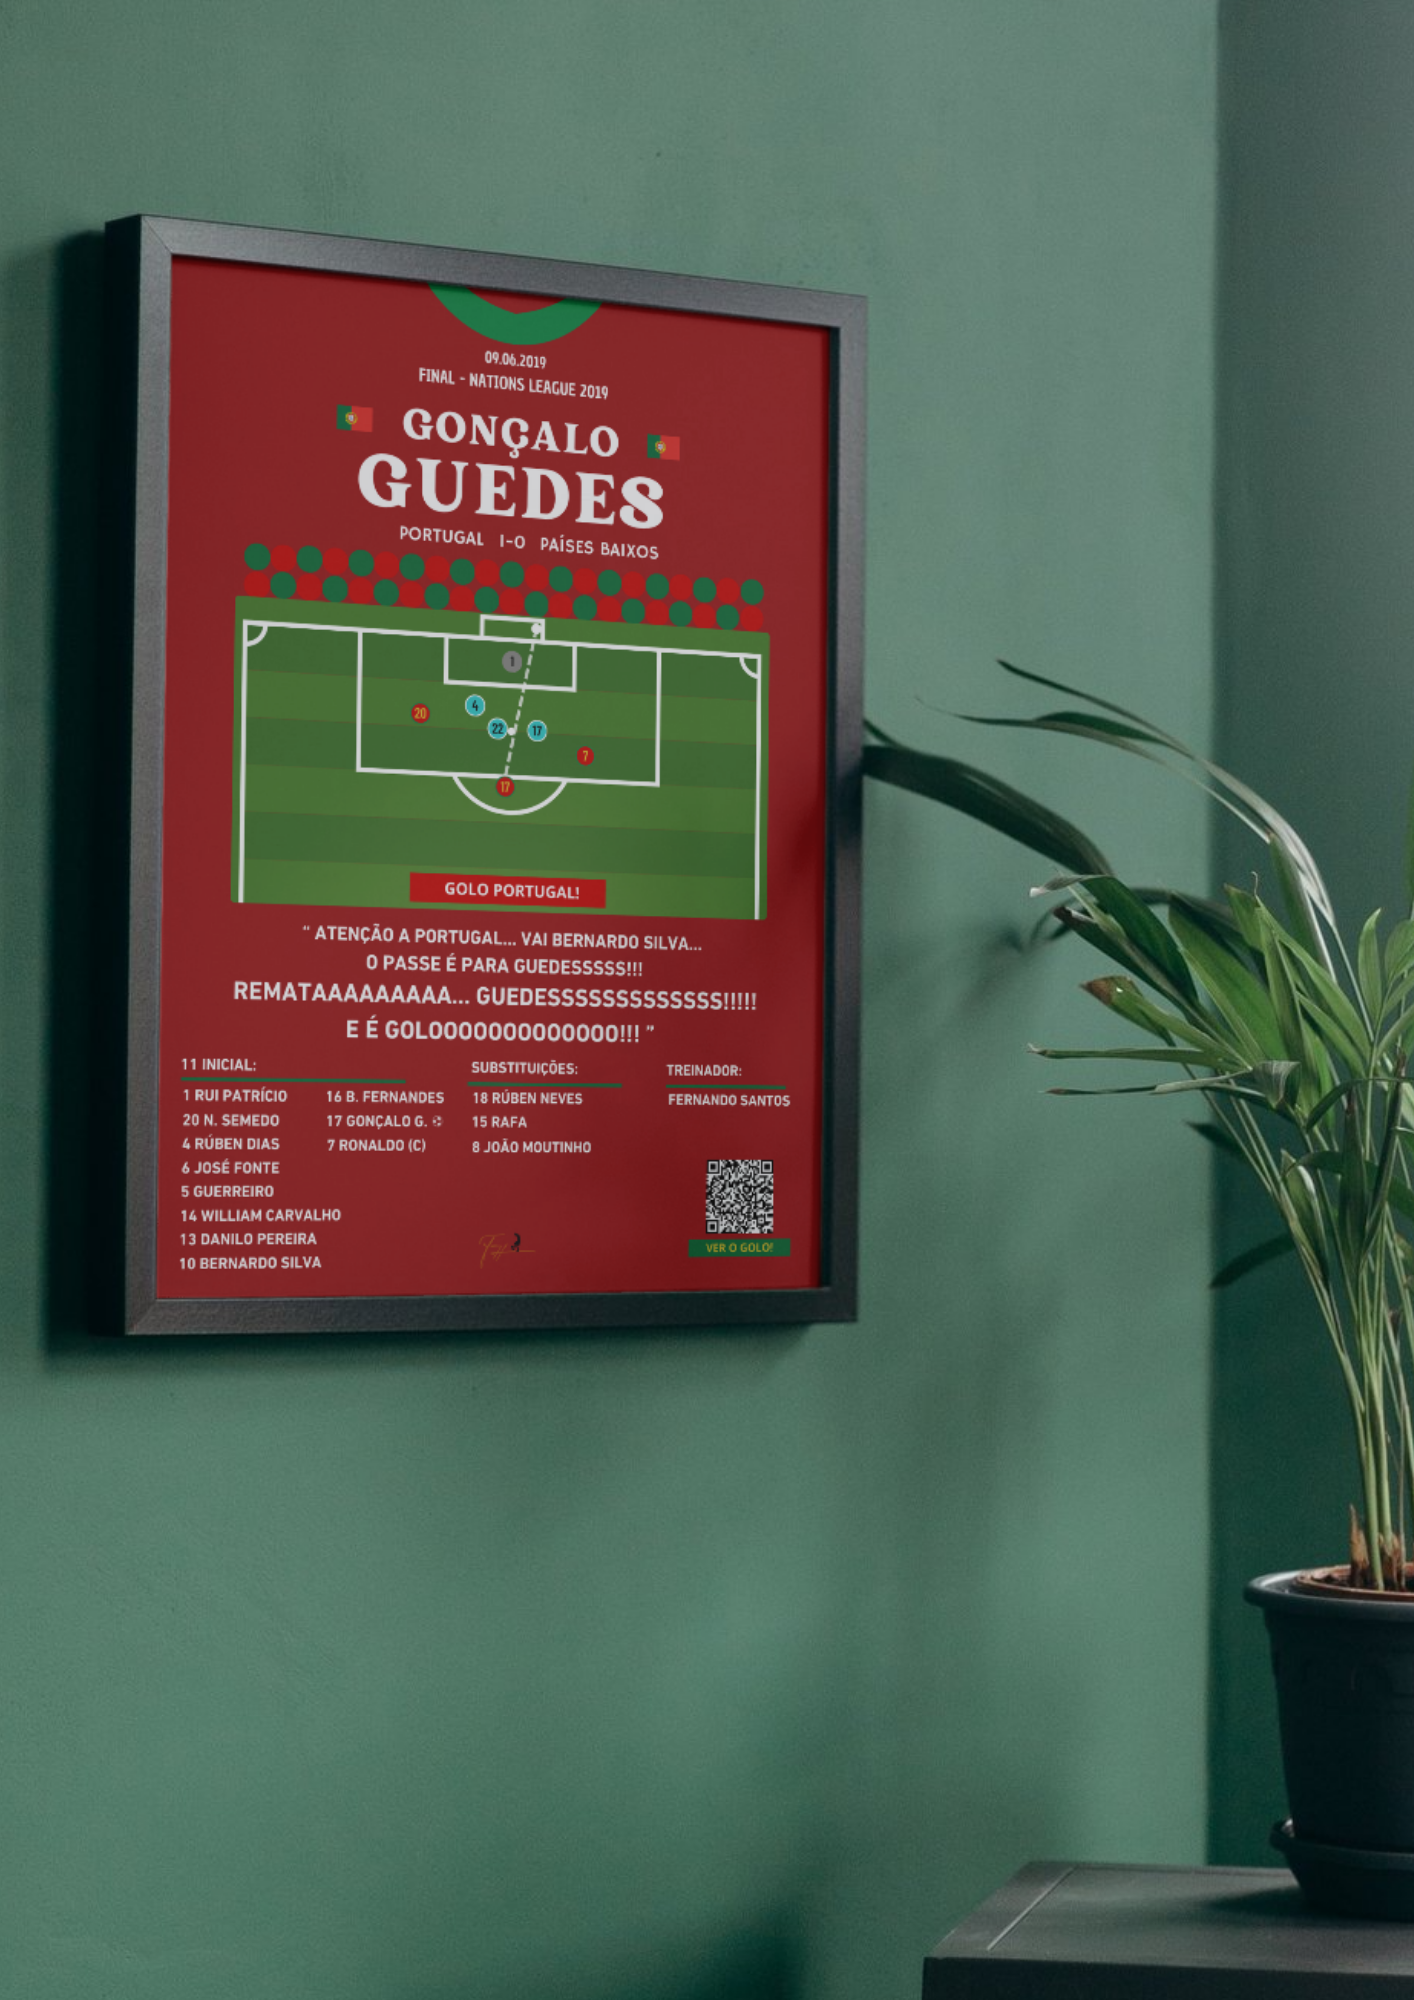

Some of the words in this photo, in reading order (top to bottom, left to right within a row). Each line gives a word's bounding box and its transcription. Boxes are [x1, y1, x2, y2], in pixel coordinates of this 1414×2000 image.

[485, 351, 546, 369] 09.06.2019
[419, 368, 455, 384] FINAL
[470, 373, 525, 391] NATIONS
[529, 379, 575, 396] LEAGUE
[580, 384, 608, 399] 2019
[403, 408, 619, 458] GONÇALO
[358, 453, 664, 529] GUEDES
[400, 526, 484, 546] PORTUGAL
[541, 535, 594, 554] PAÍSES
[601, 542, 658, 559] BAIXOS
[509, 655, 517, 667] 1
[413, 706, 427, 720] 20
[471, 699, 479, 713] 4
[491, 721, 505, 735] 22
[531, 724, 543, 737] 17
[582, 749, 589, 762] 7
[499, 780, 511, 793] 17
[445, 882, 488, 896] GOLO
[494, 884, 579, 899] PORTUGAL!
[315, 924, 393, 944] ATENÇÃO
[399, 928, 410, 942] A
[416, 928, 516, 945] PORTUGAL...
[522, 932, 547, 946] VAI
[553, 933, 638, 949] BERNARDO
[644, 936, 701, 950] SILVA...
[367, 954, 378, 970] O
[384, 955, 441, 971] PASSE
[447, 953, 456, 971] É
[462, 957, 508, 973] PARA
[514, 959, 642, 976] GUEDESSSSS!!!
[234, 981, 469, 1004] REMATAAAAAAAAA...
[347, 1020, 358, 1038] E
[367, 1015, 378, 1038] É
[183, 1059, 196, 1070] 11
[203, 1059, 257, 1071] INICIAL:
[472, 1060, 577, 1076] SUBSTITUIÇÕES:
[667, 1065, 741, 1076] TREINADOR:
[184, 1089, 188, 1100] 1
[195, 1089, 218, 1101] RUI
[223, 1087, 287, 1102] PATRÍCIO
[327, 1091, 341, 1102] 16
[347, 1091, 358, 1102] B.
[363, 1091, 444, 1103] FERNANDES
[474, 1092, 488, 1103] 18
[493, 1090, 536, 1103] RÚBEN
[541, 1092, 582, 1104] NEVES
[669, 1094, 737, 1105] FERNANDO
[741, 1095, 790, 1106] SANTOS
[183, 1114, 199, 1126] 20
[204, 1114, 217, 1126] N.
[222, 1114, 279, 1126] SEMEDO
[327, 1115, 342, 1126] 17
[347, 1115, 410, 1129] GONÇALO
[415, 1115, 427, 1127] G.
[473, 1116, 487, 1128] 15
[492, 1116, 527, 1128] RAFA
[183, 1138, 190, 1149] 4
[195, 1134, 242, 1149] RÚBEN
[247, 1138, 280, 1149] DIAS
[327, 1139, 335, 1151] 7
[339, 1139, 404, 1151] RONALDO
[408, 1139, 426, 1152] (C)
[473, 1141, 479, 1152] 8
[484, 1138, 519, 1152] JOÃO
[523, 1141, 591, 1153] MOUTINHO
[182, 1162, 189, 1174] 6
[194, 1159, 229, 1174] JOSÉ
[235, 1162, 279, 1174] FONTE
[181, 1186, 189, 1197] 5
[194, 1186, 274, 1197] GUERREIRO
[182, 1210, 197, 1221] 14
[201, 1209, 261, 1221] WILLIAM
[266, 1209, 341, 1221] CARVALHO
[181, 1233, 196, 1245] 13
[201, 1233, 252, 1245] DANILO
[258, 1233, 317, 1244] PEREIRA
[705, 1242, 726, 1254] VER
[728, 1242, 737, 1254] O
[739, 1242, 773, 1254] GOLO!
[179, 1257, 196, 1270] 10
[200, 1257, 278, 1270] BERNARDO
[280, 1256, 322, 1269] SILVA
